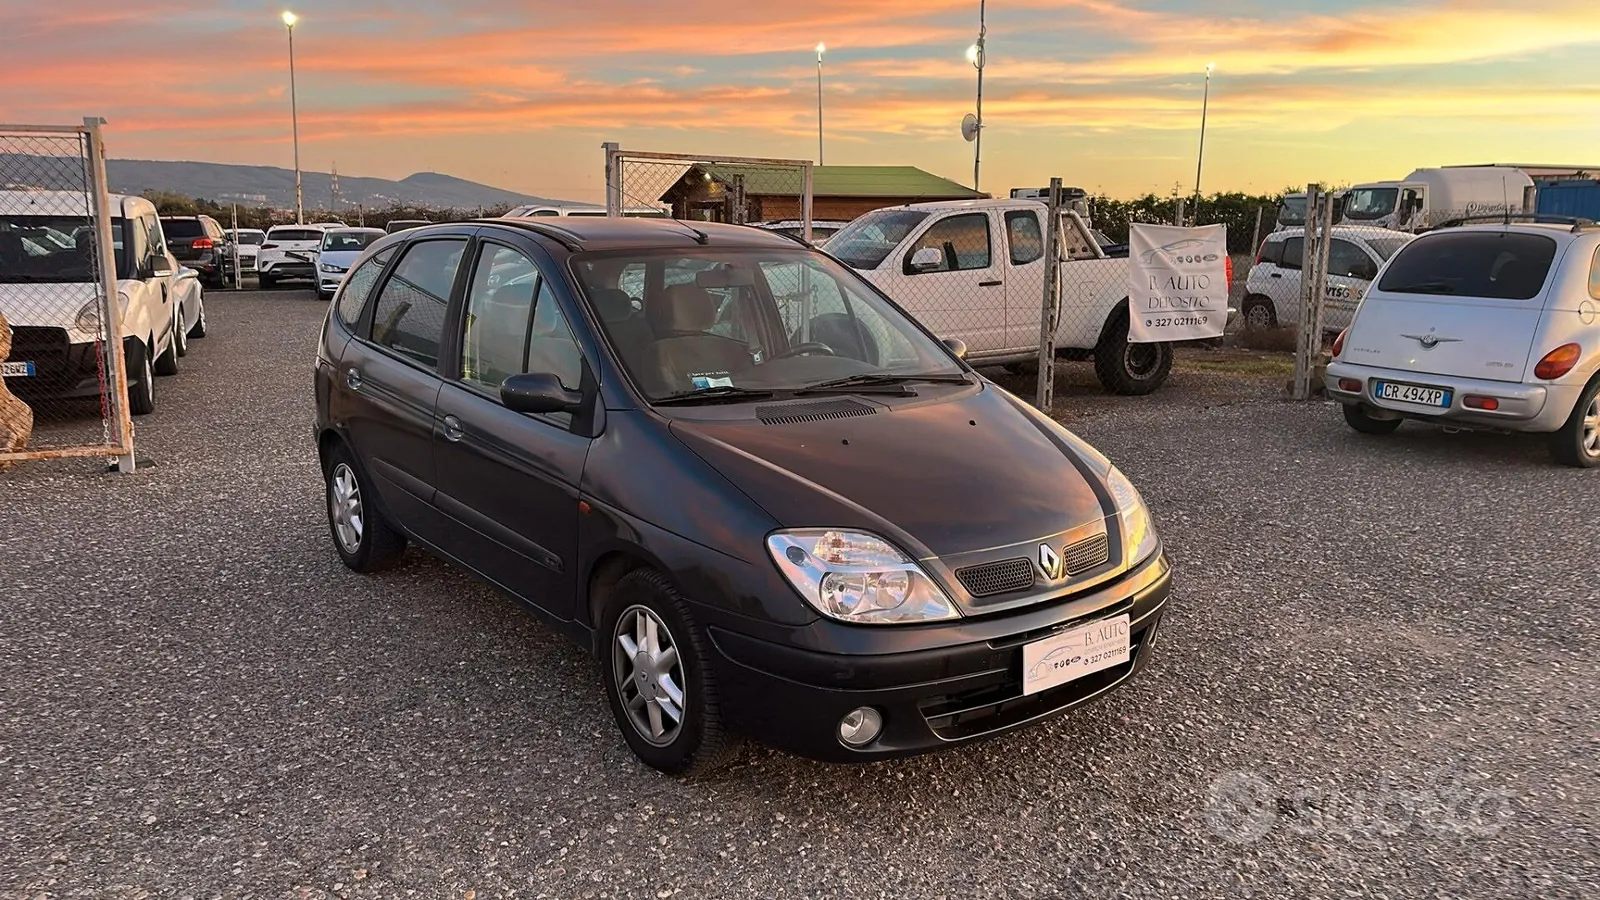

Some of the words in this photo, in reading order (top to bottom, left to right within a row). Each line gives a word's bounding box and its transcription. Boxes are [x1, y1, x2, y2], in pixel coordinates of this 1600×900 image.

[1164, 274, 1211, 291] AUTO
[1148, 296, 1210, 309] DEPOSITO
[1155, 319, 1172, 327] 327
[1174, 316, 1208, 326] 0211169
[1384, 384, 1400, 398] CR
[1403, 387, 1442, 404] 494XP
[1097, 620, 1128, 643] AUTO
[1090, 653, 1102, 664] 327
[1103, 645, 1127, 659] 0211169
